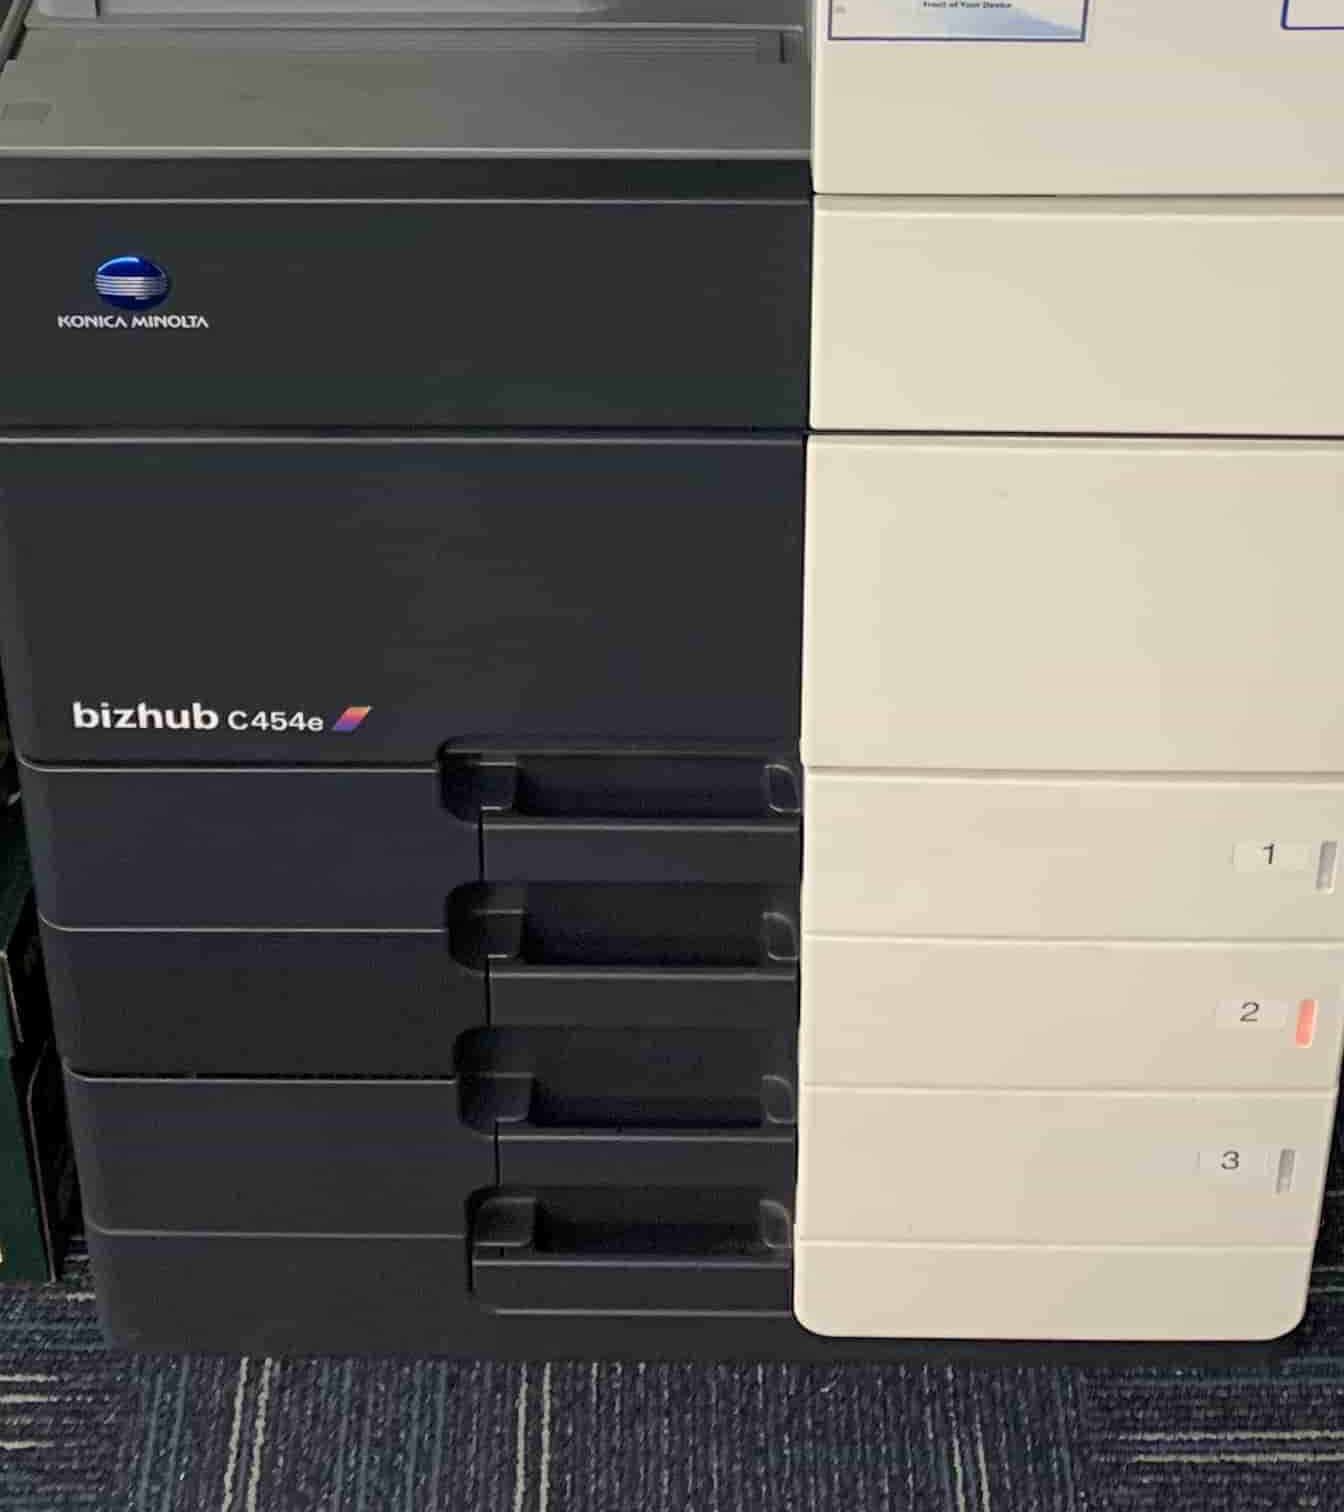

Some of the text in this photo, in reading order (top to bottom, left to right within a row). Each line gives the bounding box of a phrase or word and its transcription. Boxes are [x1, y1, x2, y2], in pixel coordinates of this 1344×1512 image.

[57, 314, 210, 329] KONICA MINOLTA
[72, 701, 325, 731] bizhub C454e
[1262, 843, 1275, 865] 1
[1239, 1001, 1260, 1022] 2
[1220, 1150, 1241, 1171] 3
